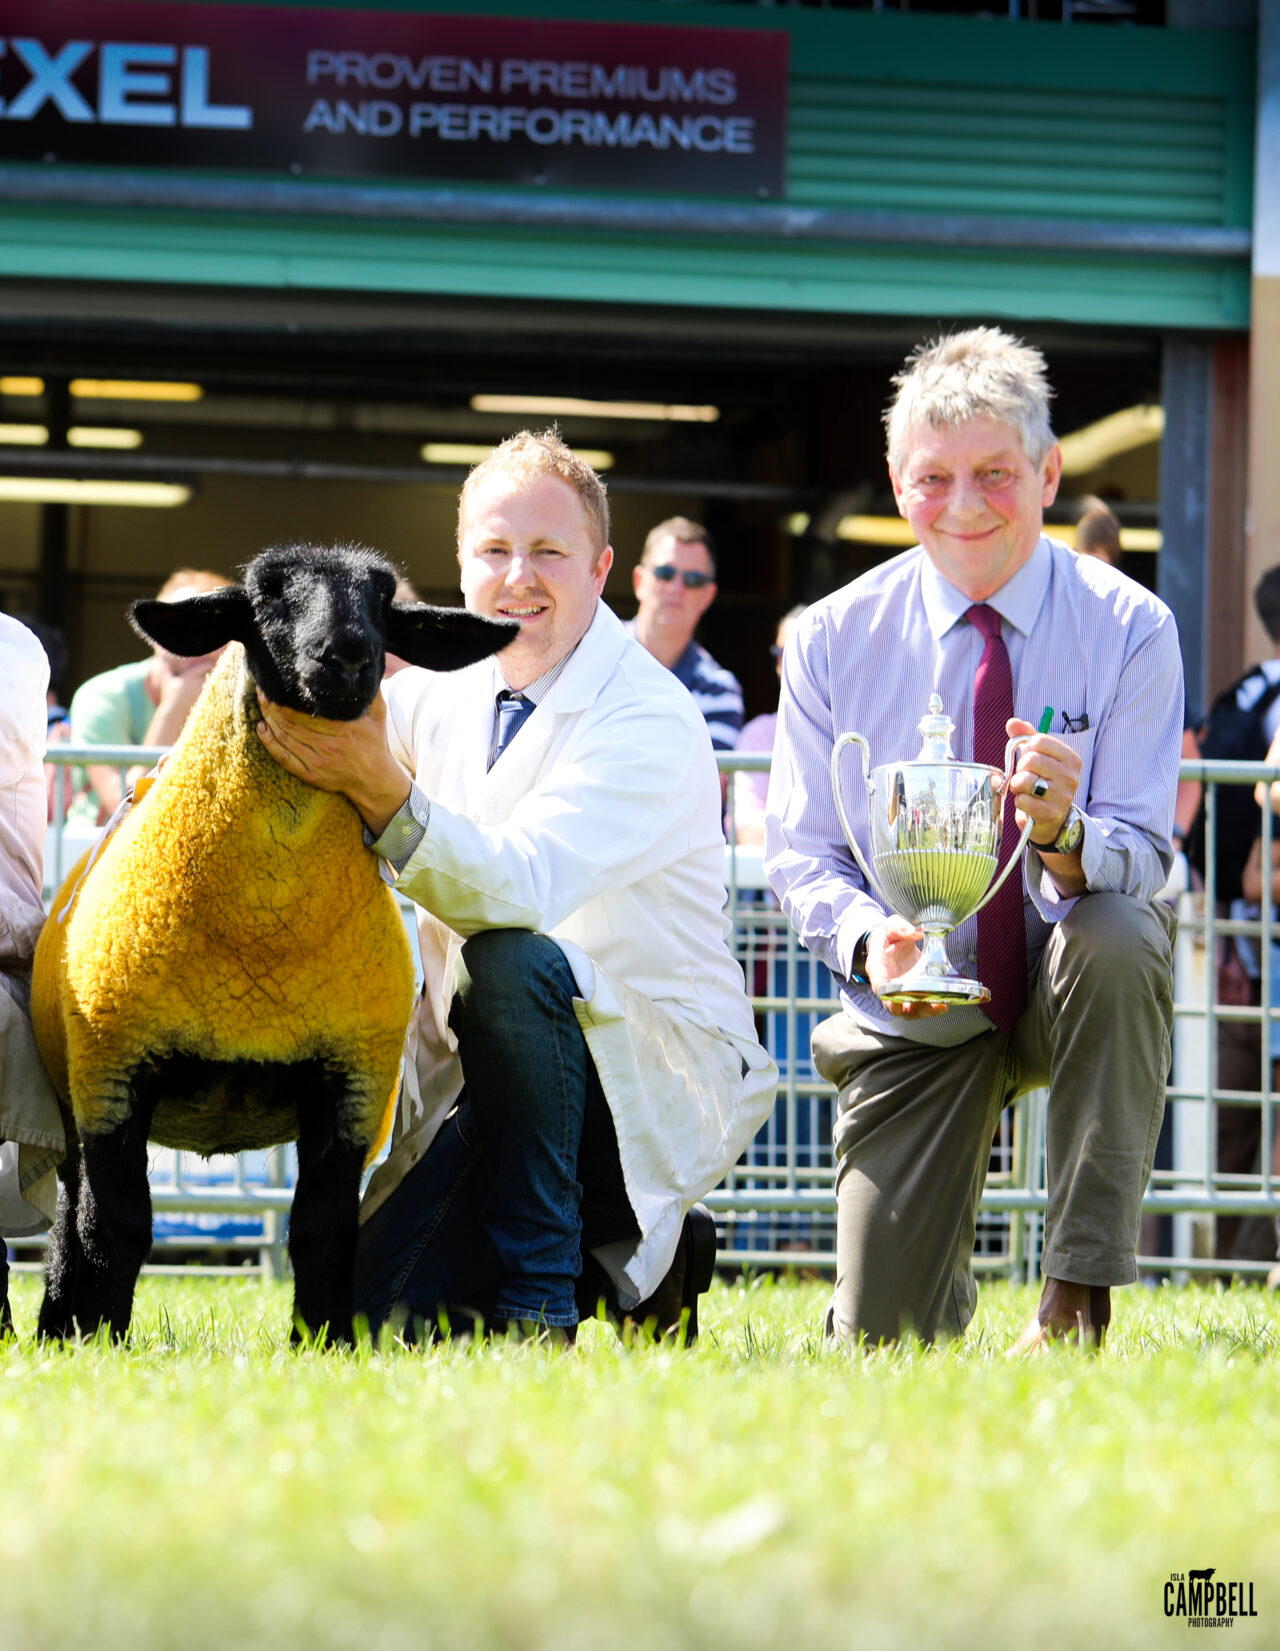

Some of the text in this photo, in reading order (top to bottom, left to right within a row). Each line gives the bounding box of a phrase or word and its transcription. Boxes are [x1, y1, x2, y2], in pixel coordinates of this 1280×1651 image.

[307, 50, 737, 104] PROVEN PREMIUMS
[304, 99, 755, 154] AND PERFORMANCE
